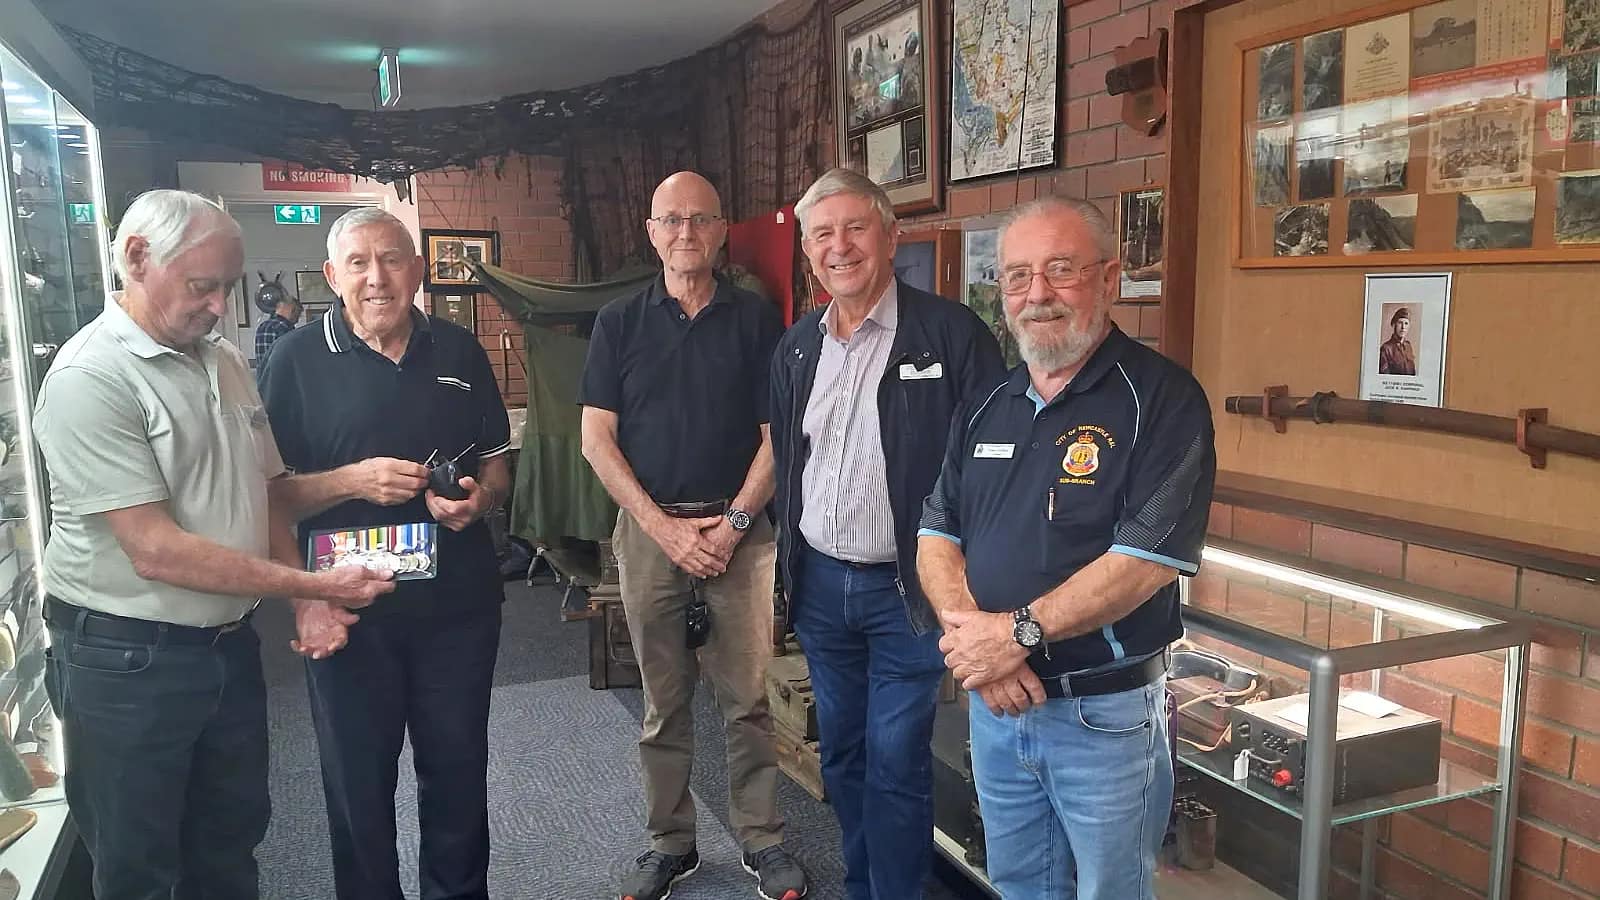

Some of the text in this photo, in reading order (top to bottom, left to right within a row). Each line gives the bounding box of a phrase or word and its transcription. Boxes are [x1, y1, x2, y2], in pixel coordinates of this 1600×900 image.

[270, 170, 285, 182] NO
[1055, 434, 1067, 446] CITY
[1078, 425, 1109, 438] NEWCASTLE
[1059, 478, 1095, 486] SUB-BRANCH
